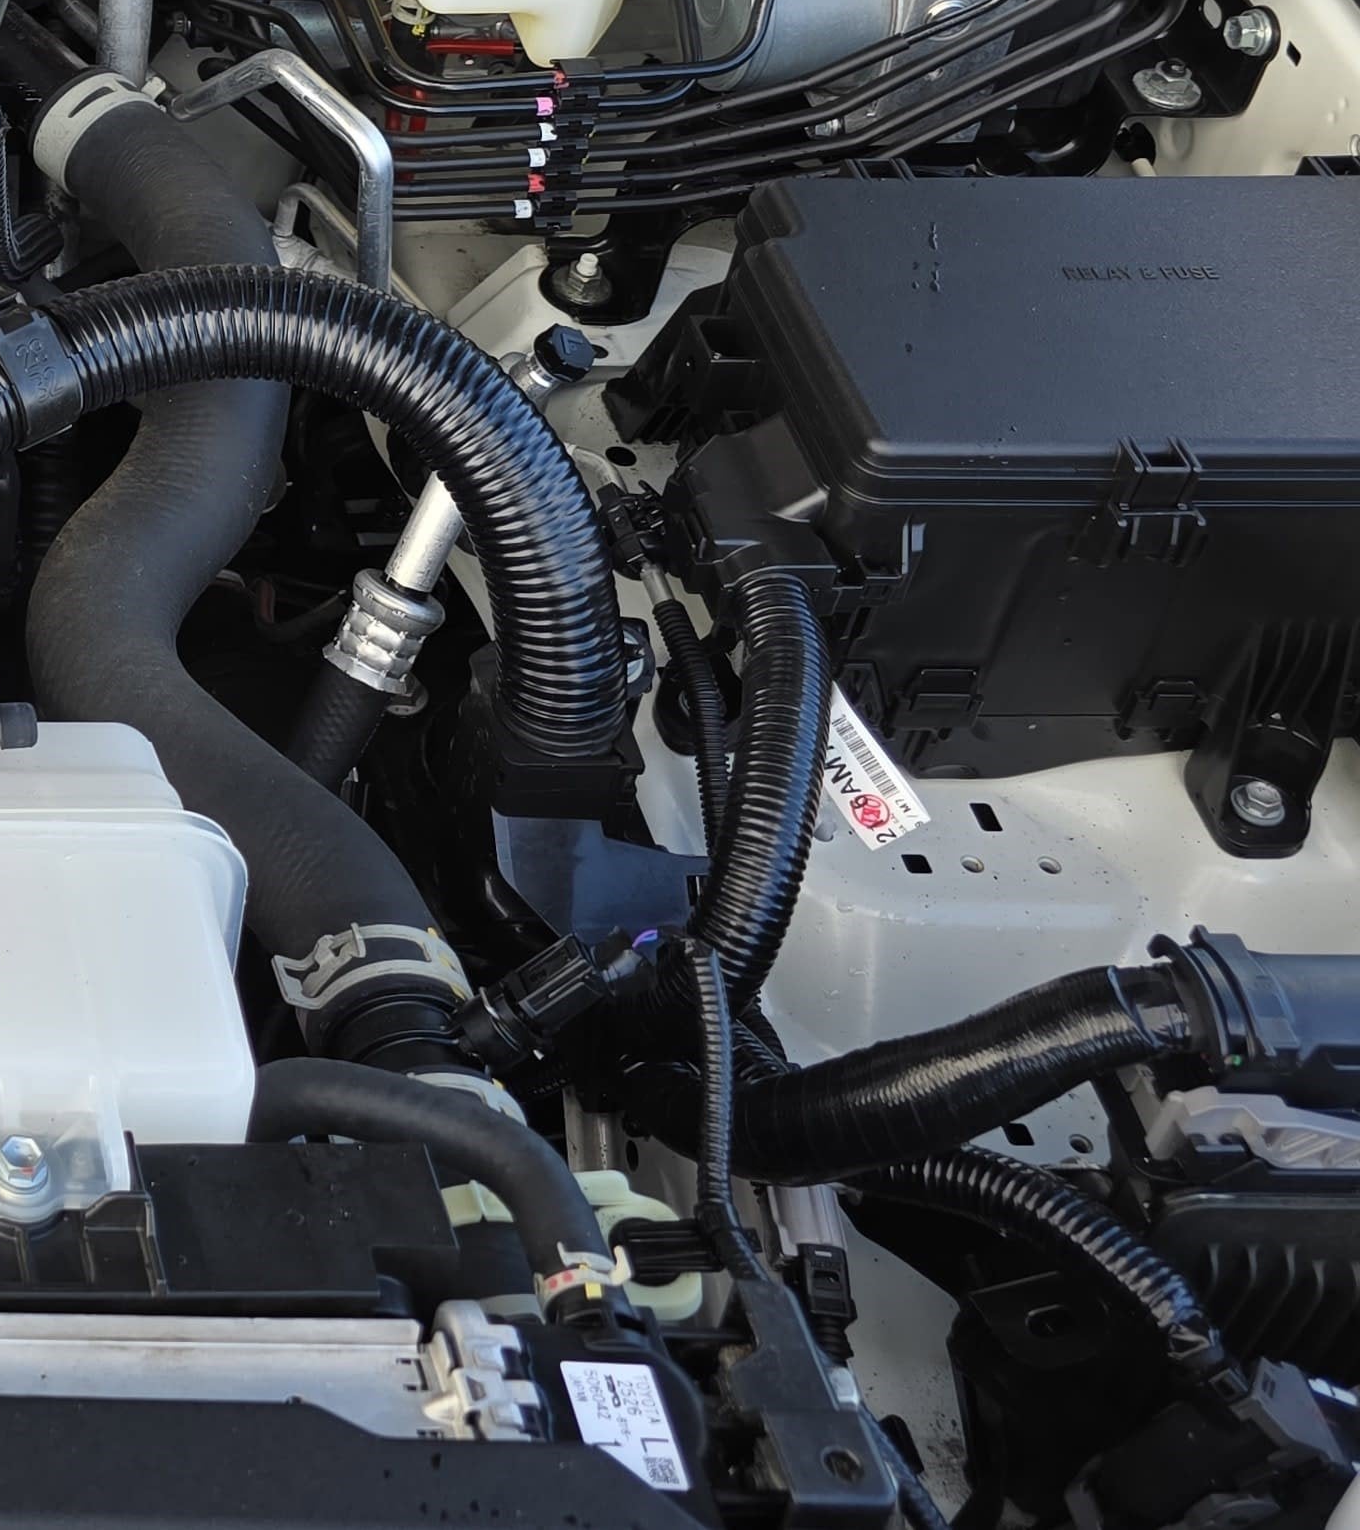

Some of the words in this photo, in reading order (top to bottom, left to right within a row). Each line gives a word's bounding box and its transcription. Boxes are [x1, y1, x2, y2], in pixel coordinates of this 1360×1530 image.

[1061, 266, 1132, 281] RELAY
[1159, 265, 1221, 281] FUSE
[617, 1379, 642, 1418] 2526
[635, 1374, 662, 1424] TOYOTA
[640, 1437, 669, 1454] L
